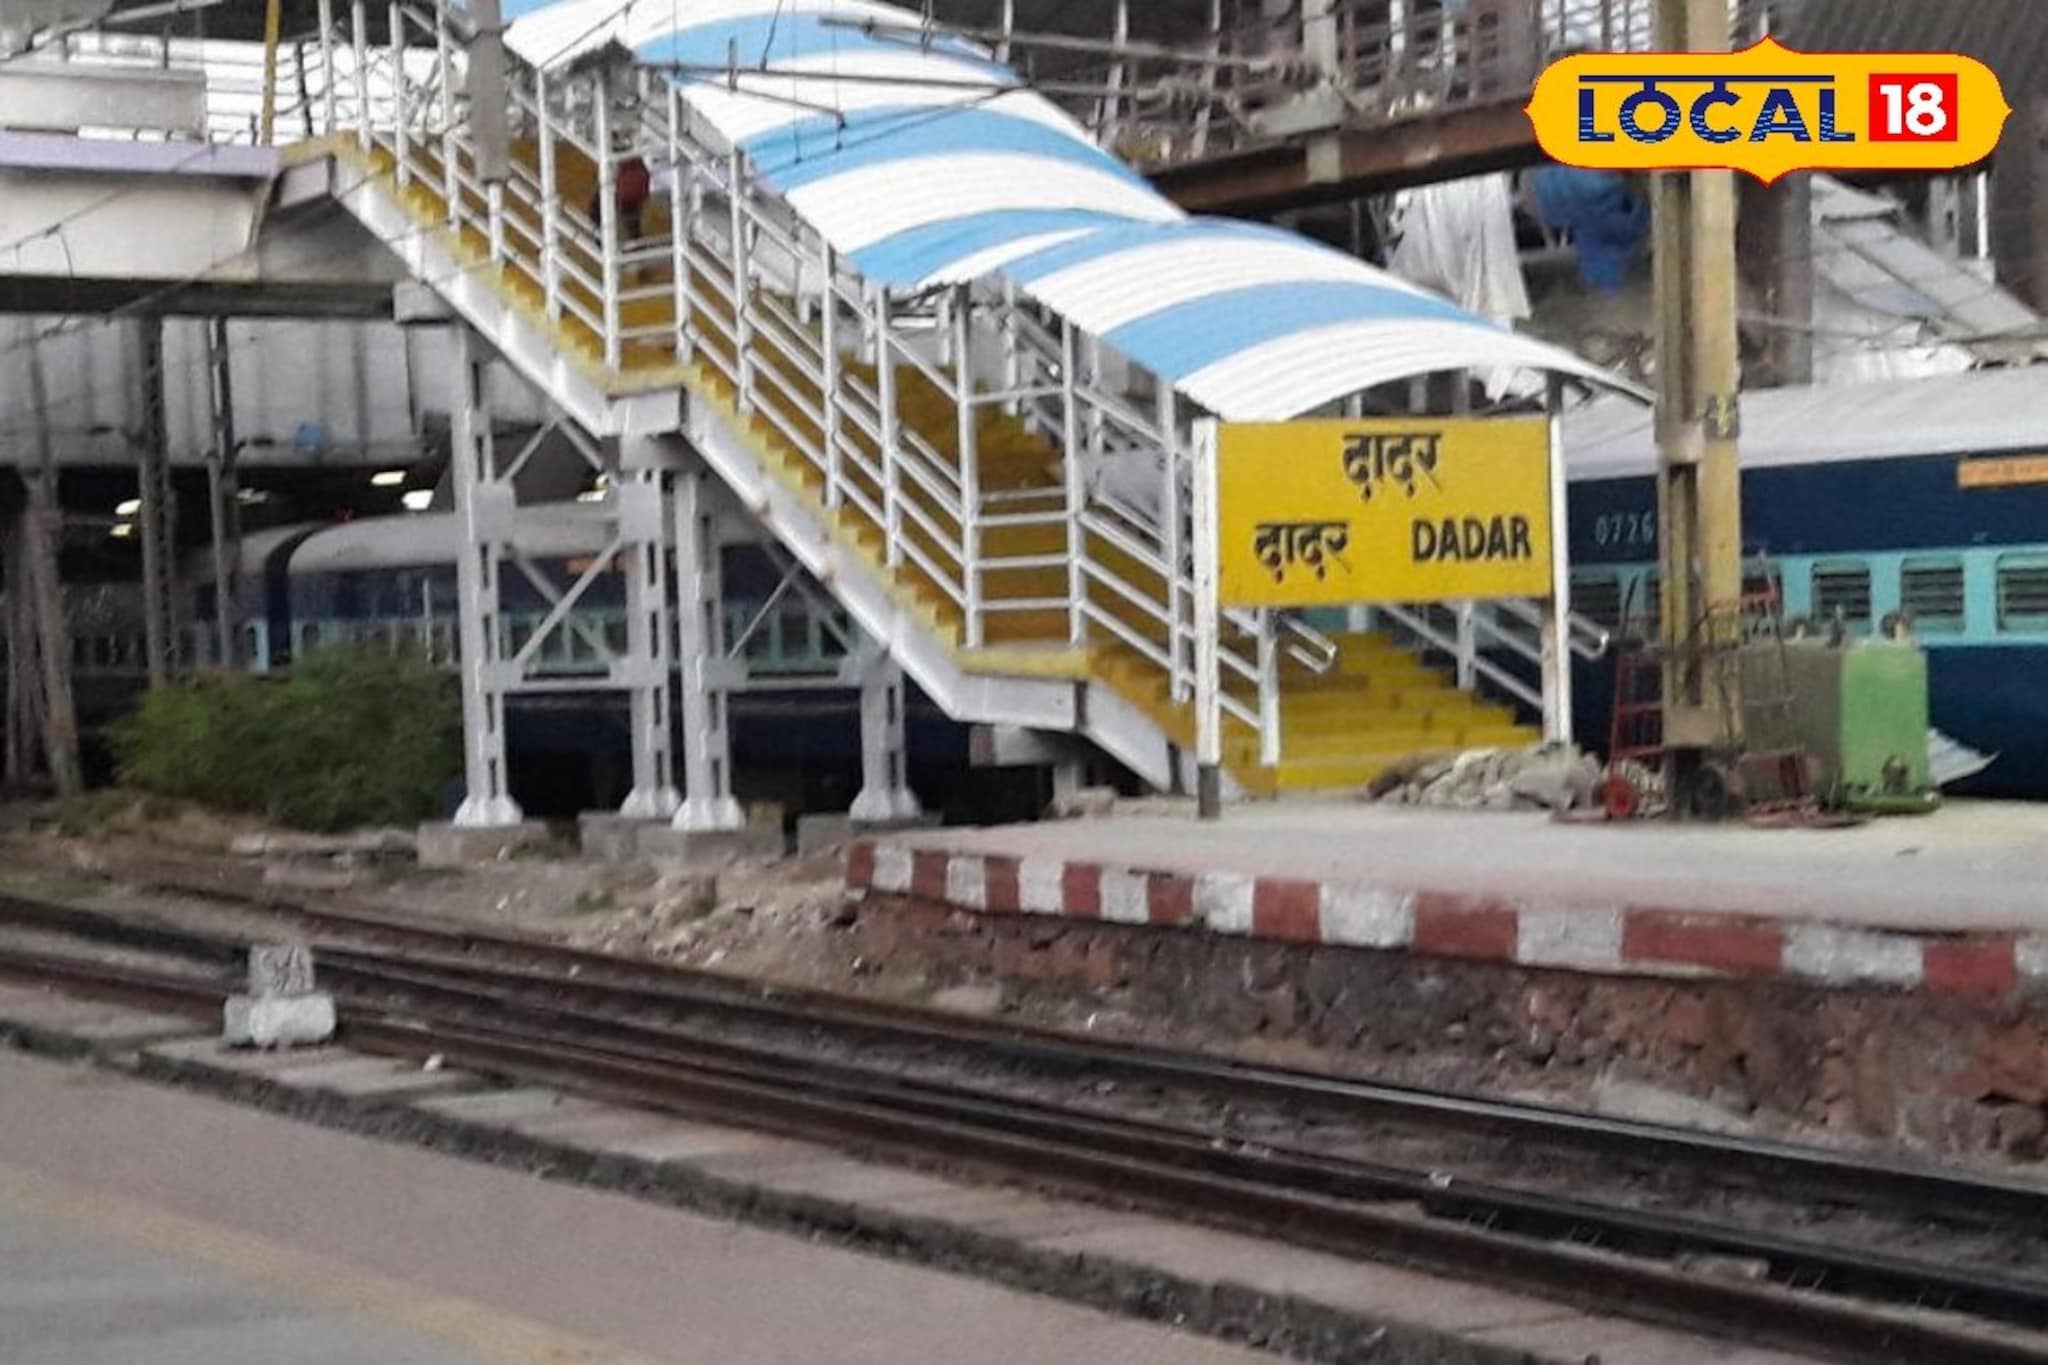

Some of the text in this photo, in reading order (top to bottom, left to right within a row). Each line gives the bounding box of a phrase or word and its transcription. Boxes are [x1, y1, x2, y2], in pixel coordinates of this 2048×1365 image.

[1343, 433, 1442, 502] दादर
[1254, 523, 1352, 583] दादर
[1411, 515, 1532, 563] DADAR
